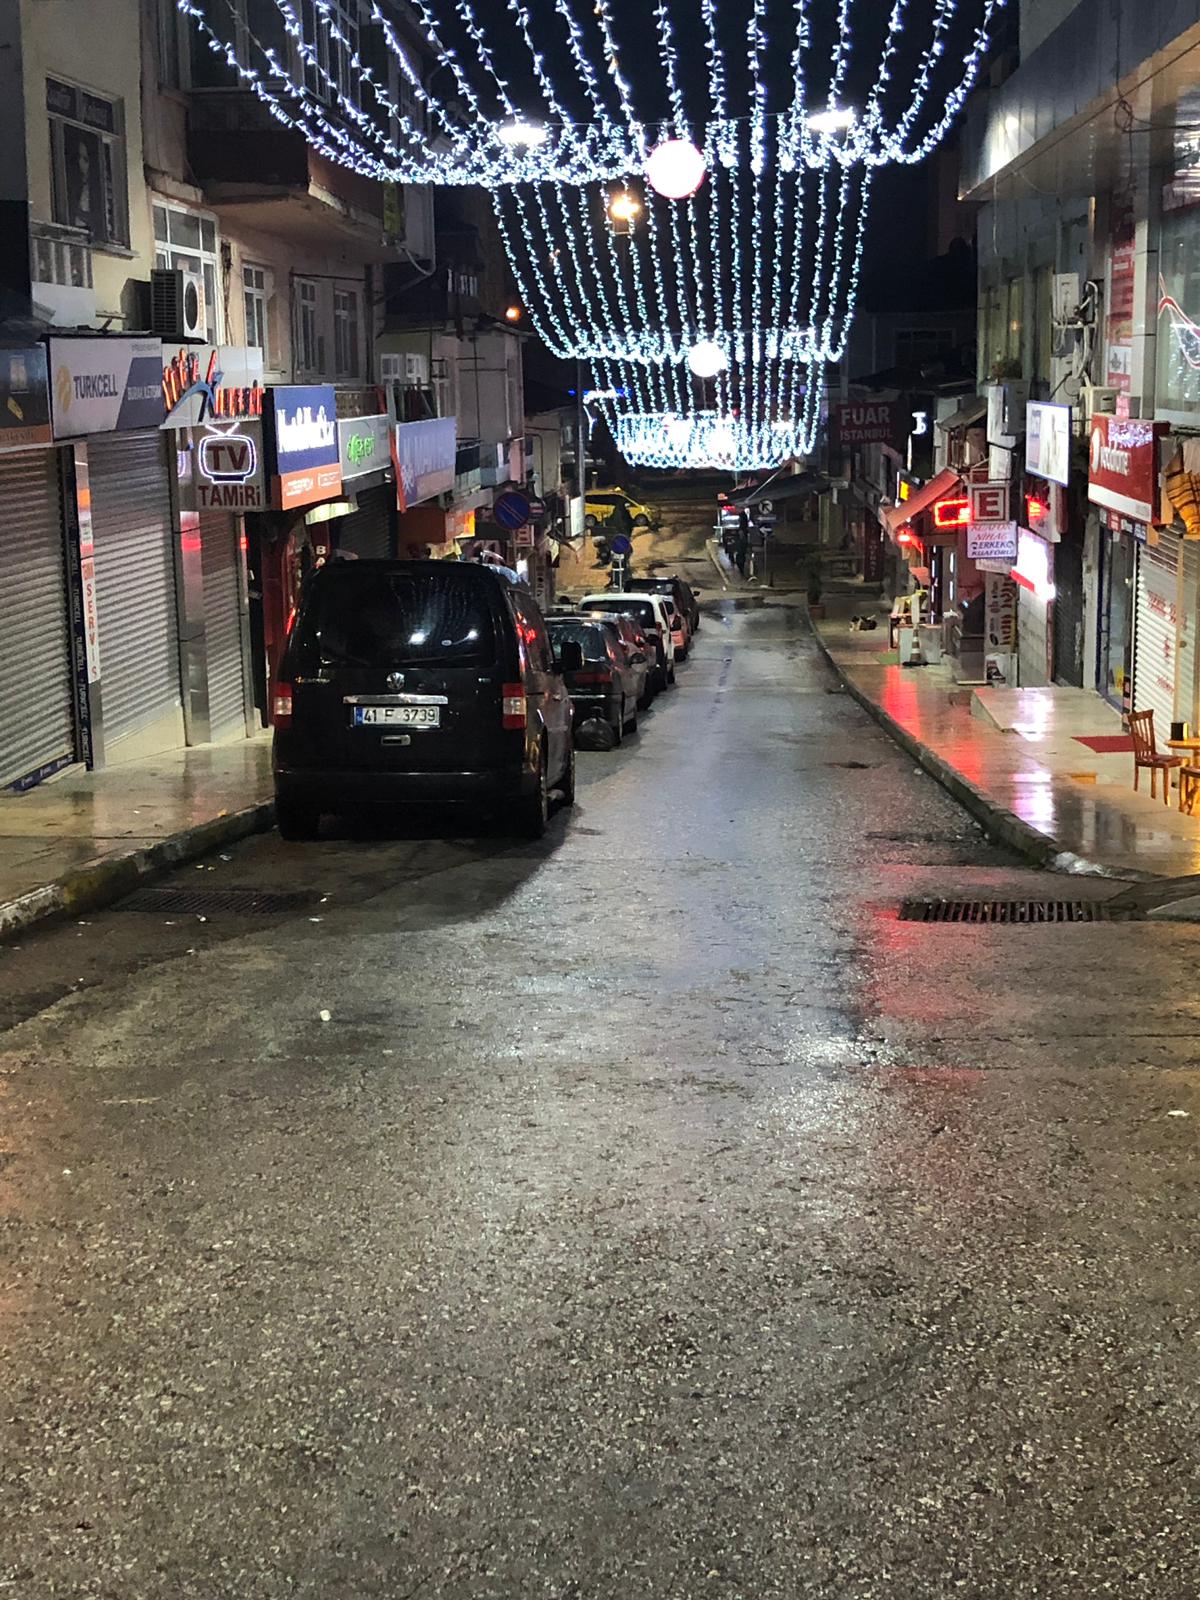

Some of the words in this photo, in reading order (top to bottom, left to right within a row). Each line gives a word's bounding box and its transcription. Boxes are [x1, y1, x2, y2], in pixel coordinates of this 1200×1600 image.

[73, 374, 118, 400] TURKCELL
[841, 406, 890, 426] FUAR
[207, 445, 247, 471] TV
[979, 492, 1000, 517] E
[978, 541, 1006, 549] ERKEK
[363, 709, 377, 722] 41
[384, 709, 394, 722] F
[403, 708, 436, 722] 3739
